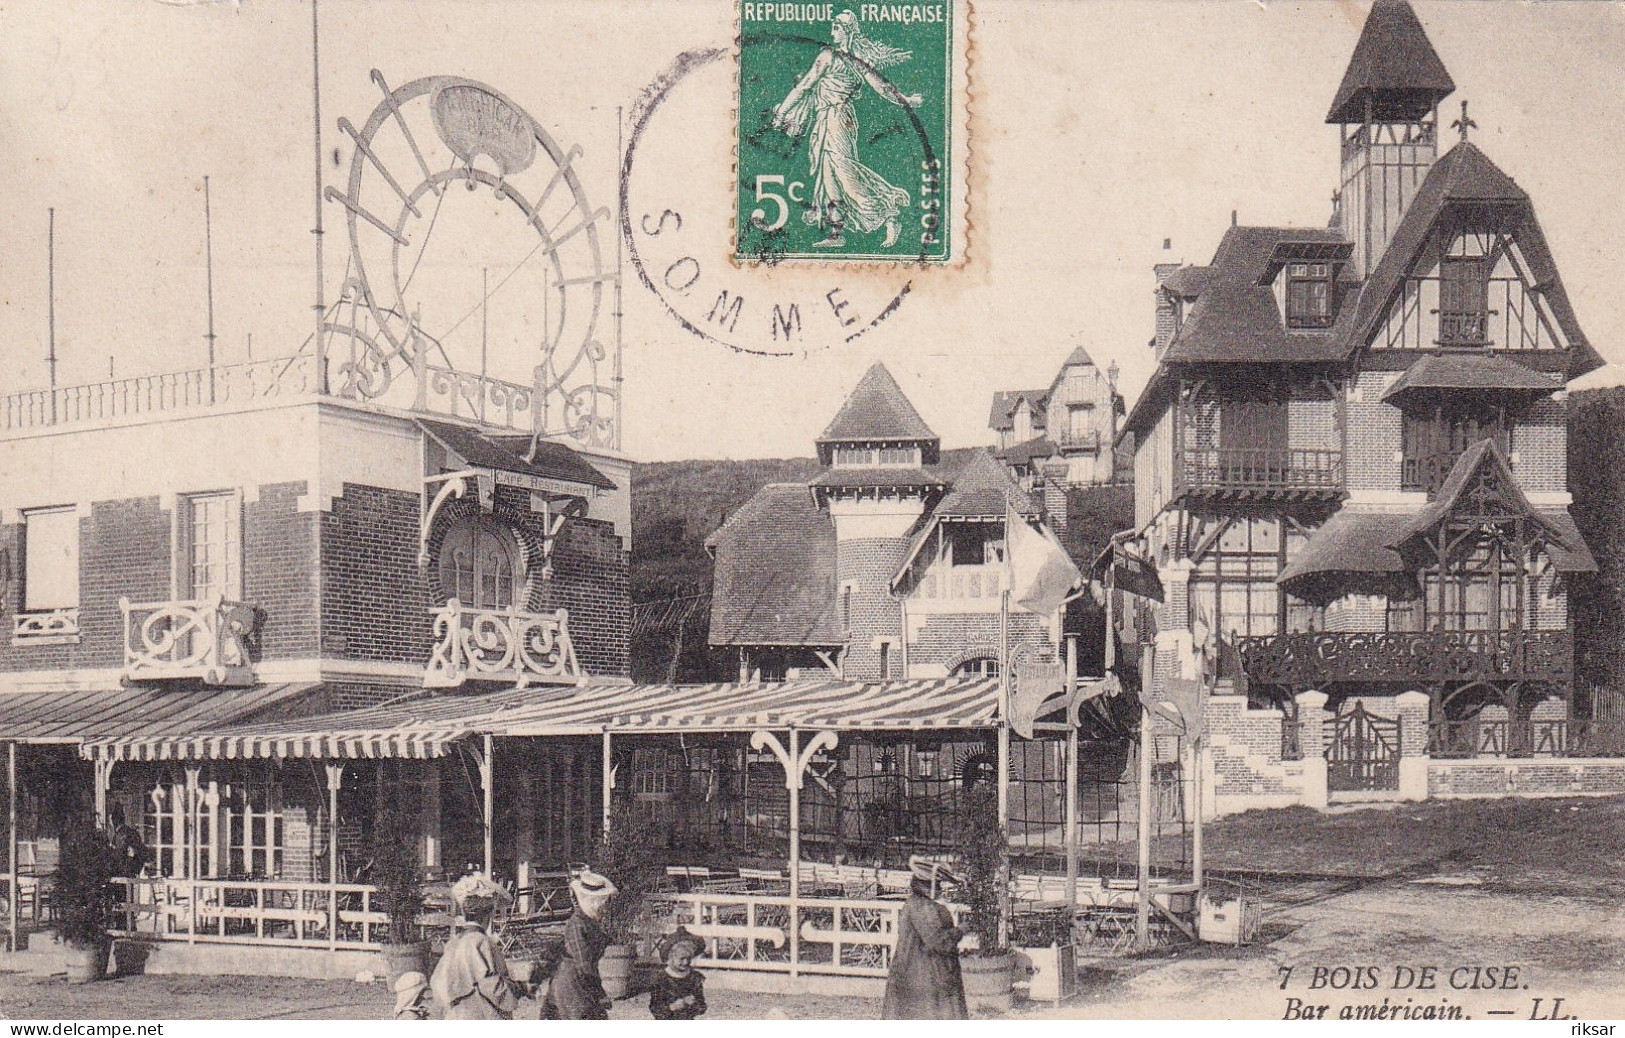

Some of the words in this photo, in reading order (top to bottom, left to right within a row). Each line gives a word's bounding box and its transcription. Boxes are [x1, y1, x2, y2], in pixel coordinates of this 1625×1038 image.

[744, 2, 834, 24] REPUBLIQUE
[861, 3, 944, 25] FRANÇAISE
[920, 158, 942, 246] POSTES
[641, 208, 857, 342] SOMME
